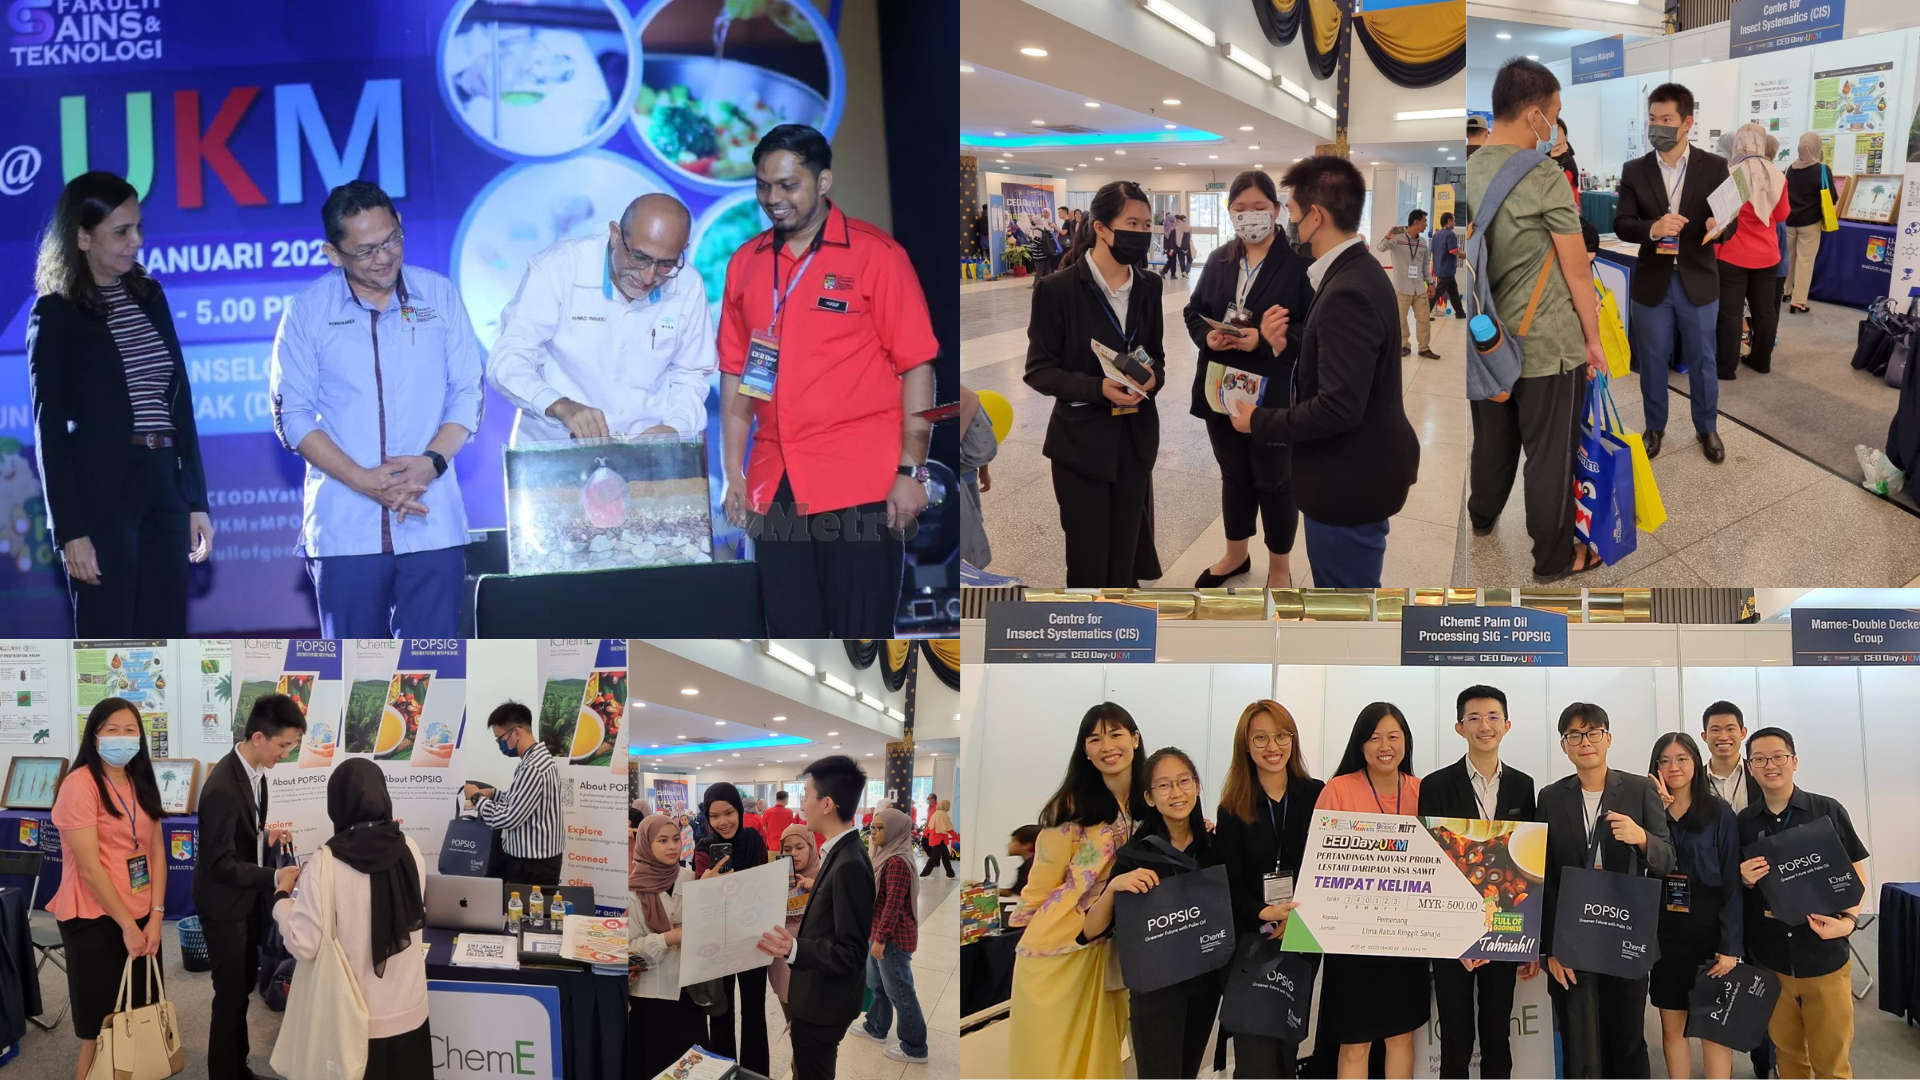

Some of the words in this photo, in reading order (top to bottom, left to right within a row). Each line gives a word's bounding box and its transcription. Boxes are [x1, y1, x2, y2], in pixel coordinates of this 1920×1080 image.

[1763, 2, 1788, 16] Centre
[1740, 23, 1761, 36] Insect
[1762, 11, 1809, 32] Systematics
[1810, 5, 1831, 22] (CIS)
[9, 39, 162, 67] TEKNOLOGI
[0, 144, 42, 196] @
[60, 79, 407, 209] UKM
[270, 238, 331, 269] 202
[196, 297, 257, 325] 5.00
[1048, 613, 1085, 625] Centre
[1087, 613, 1103, 625] for
[1440, 616, 1481, 628] iChemE
[1484, 617, 1511, 628] Palm
[1513, 616, 1528, 628] Oil
[1811, 618, 1887, 630] Mamee-Double
[1006, 628, 1045, 640] Insect
[1047, 628, 1113, 642] Systematics
[1115, 628, 1140, 642] (CIS)
[1419, 630, 1480, 644] Processing
[1482, 630, 1501, 642] SIG
[1511, 630, 1551, 643] POPSIG
[1853, 632, 1884, 645] Group
[296, 640, 336, 652] POPSIG
[411, 639, 458, 650] POPSIG
[1071, 651, 1089, 659] CEO
[1479, 654, 1499, 662] CEO
[1863, 654, 1882, 662] CEO
[272, 777, 296, 787] About
[297, 775, 327, 785] POPSIG
[409, 774, 443, 783] POPSIG
[579, 780, 607, 791] About
[609, 782, 628, 792] POP
[567, 825, 603, 837] Explore
[451, 838, 476, 849] POPSIG
[1322, 834, 1351, 849] CEO
[567, 852, 609, 865] Connect
[1315, 851, 1375, 863] PERTANDINGAN
[1376, 853, 1407, 864] INOVASI
[1409, 855, 1443, 865] PRODUK
[1777, 852, 1821, 875] POPSIG
[1317, 863, 1351, 872] LESTARI
[1351, 864, 1392, 874] DARIPADA
[1392, 866, 1411, 875] SISA
[1412, 867, 1437, 876] SAWIT
[1313, 875, 1375, 891] TEMPAT
[1377, 878, 1432, 894] KELIMA
[1780, 874, 1796, 883] Greener
[1417, 898, 1445, 910] MYR:
[1446, 899, 1478, 911] 500.00
[1583, 903, 1630, 921] POPSIG
[1147, 906, 1201, 932] POPSIG
[1376, 915, 1409, 926] Pemenang
[1493, 917, 1511, 926] FULL
[1511, 917, 1523, 926] OF
[1595, 918, 1608, 926] Future
[1615, 922, 1626, 930] Palm
[1144, 932, 1165, 942] Greener
[1164, 928, 1179, 936] Future
[1178, 924, 1189, 932] with
[1188, 921, 1200, 929] Palm
[1199, 918, 1207, 926] Oil
[1361, 927, 1378, 935] Lima
[1378, 928, 1396, 936] Ratus
[1397, 928, 1419, 938] Ringgit
[1420, 929, 1441, 938] Sahaja
[1493, 924, 1522, 932] GOODNESS
[1479, 934, 1536, 954] Tahniah!!
[1266, 970, 1295, 992] OPSIG
[430, 1034, 536, 1075] ChemE
